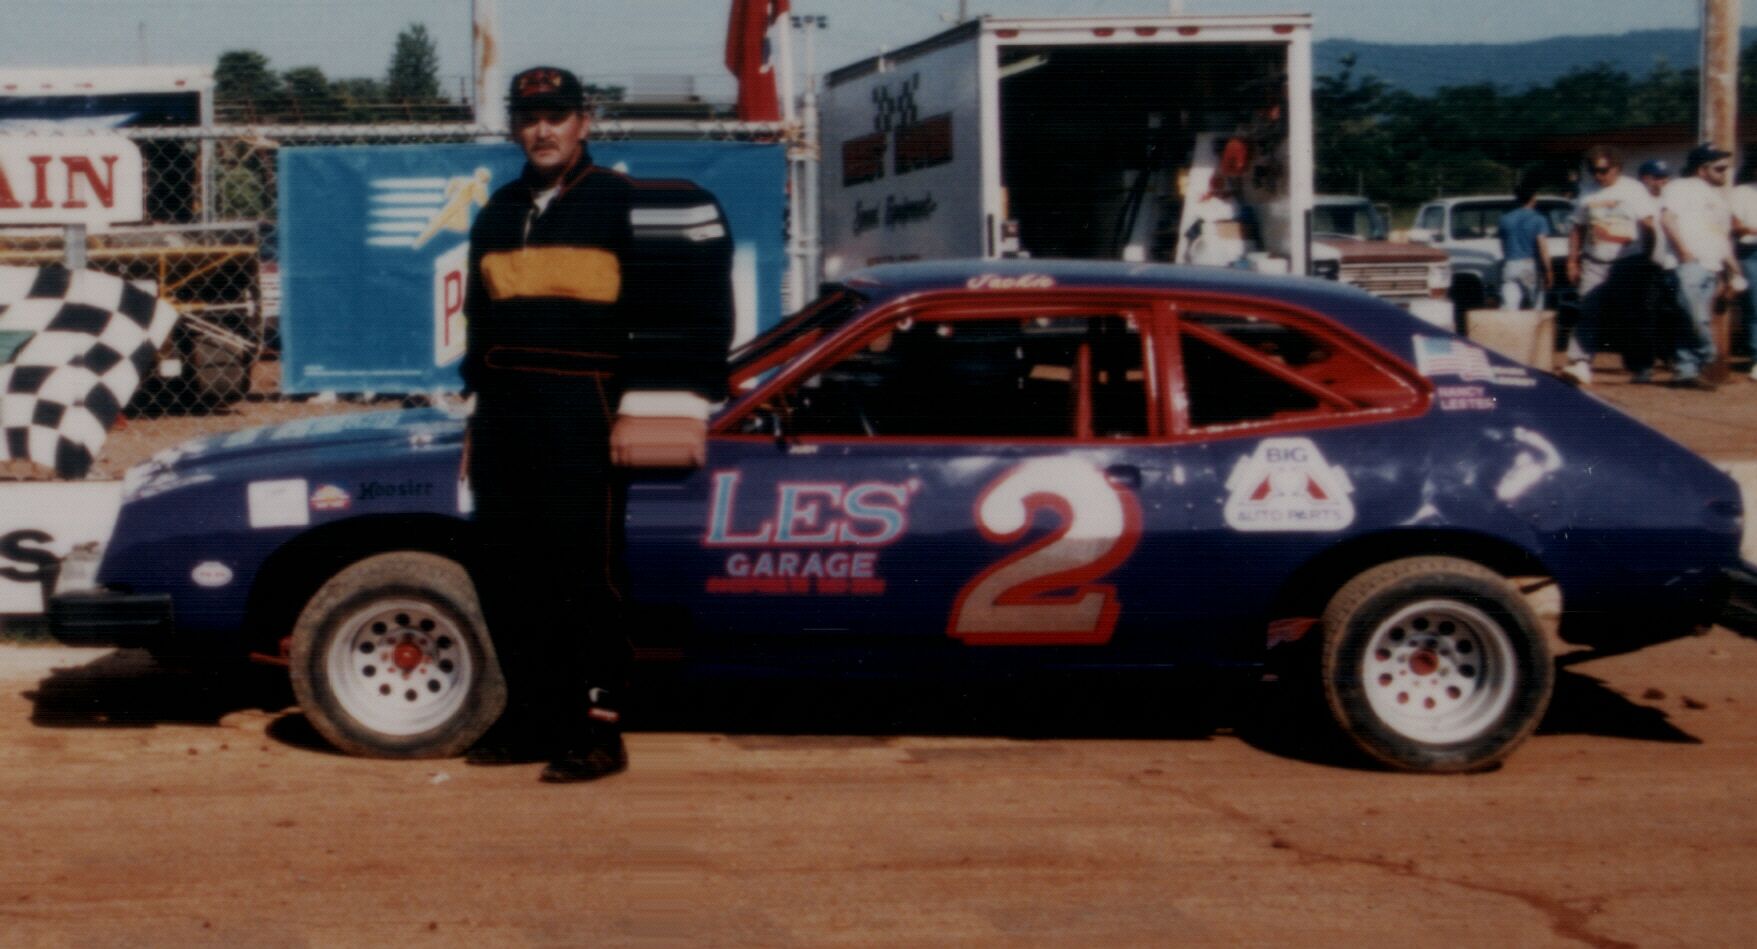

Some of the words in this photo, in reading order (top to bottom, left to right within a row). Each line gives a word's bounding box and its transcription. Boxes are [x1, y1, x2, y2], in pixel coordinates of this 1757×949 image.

[1265, 447, 1308, 463] BIG
[357, 479, 433, 500] Hoosier
[1237, 509, 1281, 522] AUTO
[1287, 509, 1344, 522] PARTS
[947, 455, 1143, 646] 2
[727, 553, 877, 579] GARAGE
